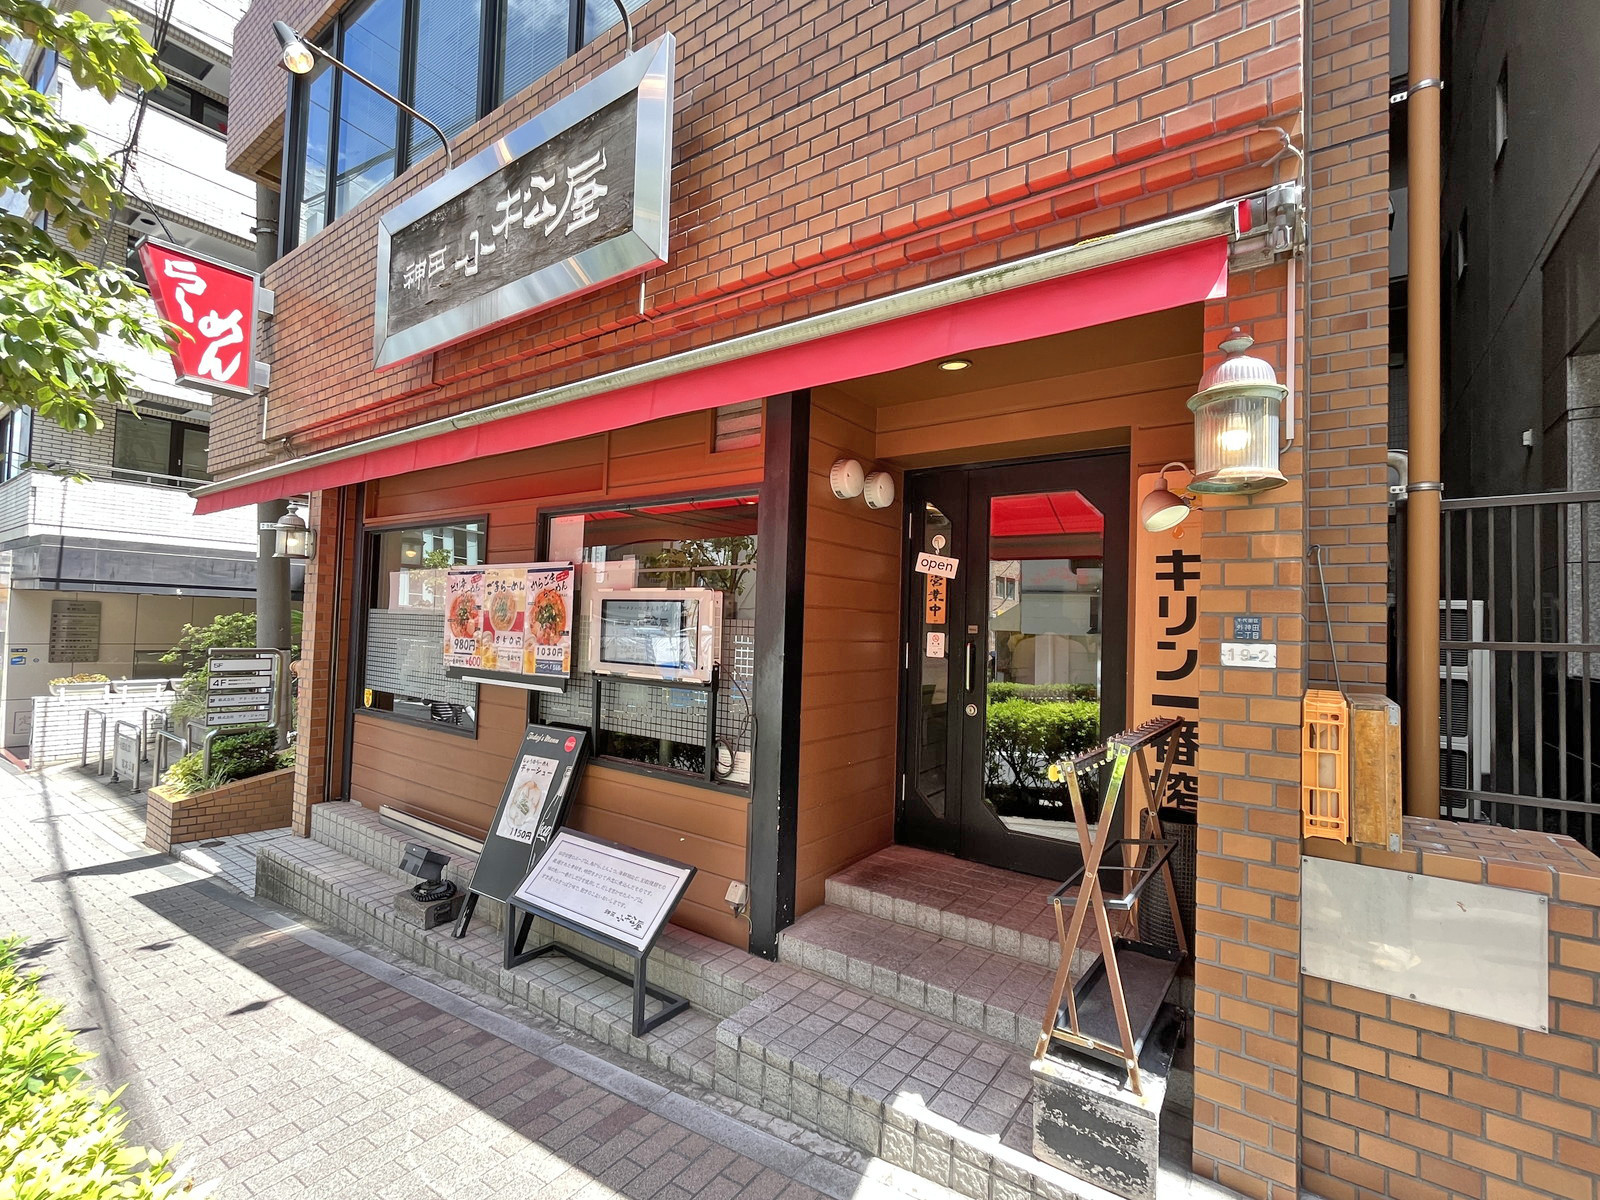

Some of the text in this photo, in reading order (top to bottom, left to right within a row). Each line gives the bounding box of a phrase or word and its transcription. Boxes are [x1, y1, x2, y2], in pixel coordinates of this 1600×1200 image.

[163, 259, 244, 381] らーめん
[920, 558, 953, 572] open
[454, 638, 475, 651] 980円
[536, 647, 563, 657] 1030円
[212, 679, 227, 687] 4F
[520, 763, 553, 777] チャーシュー
[509, 827, 533, 841] 1150円
